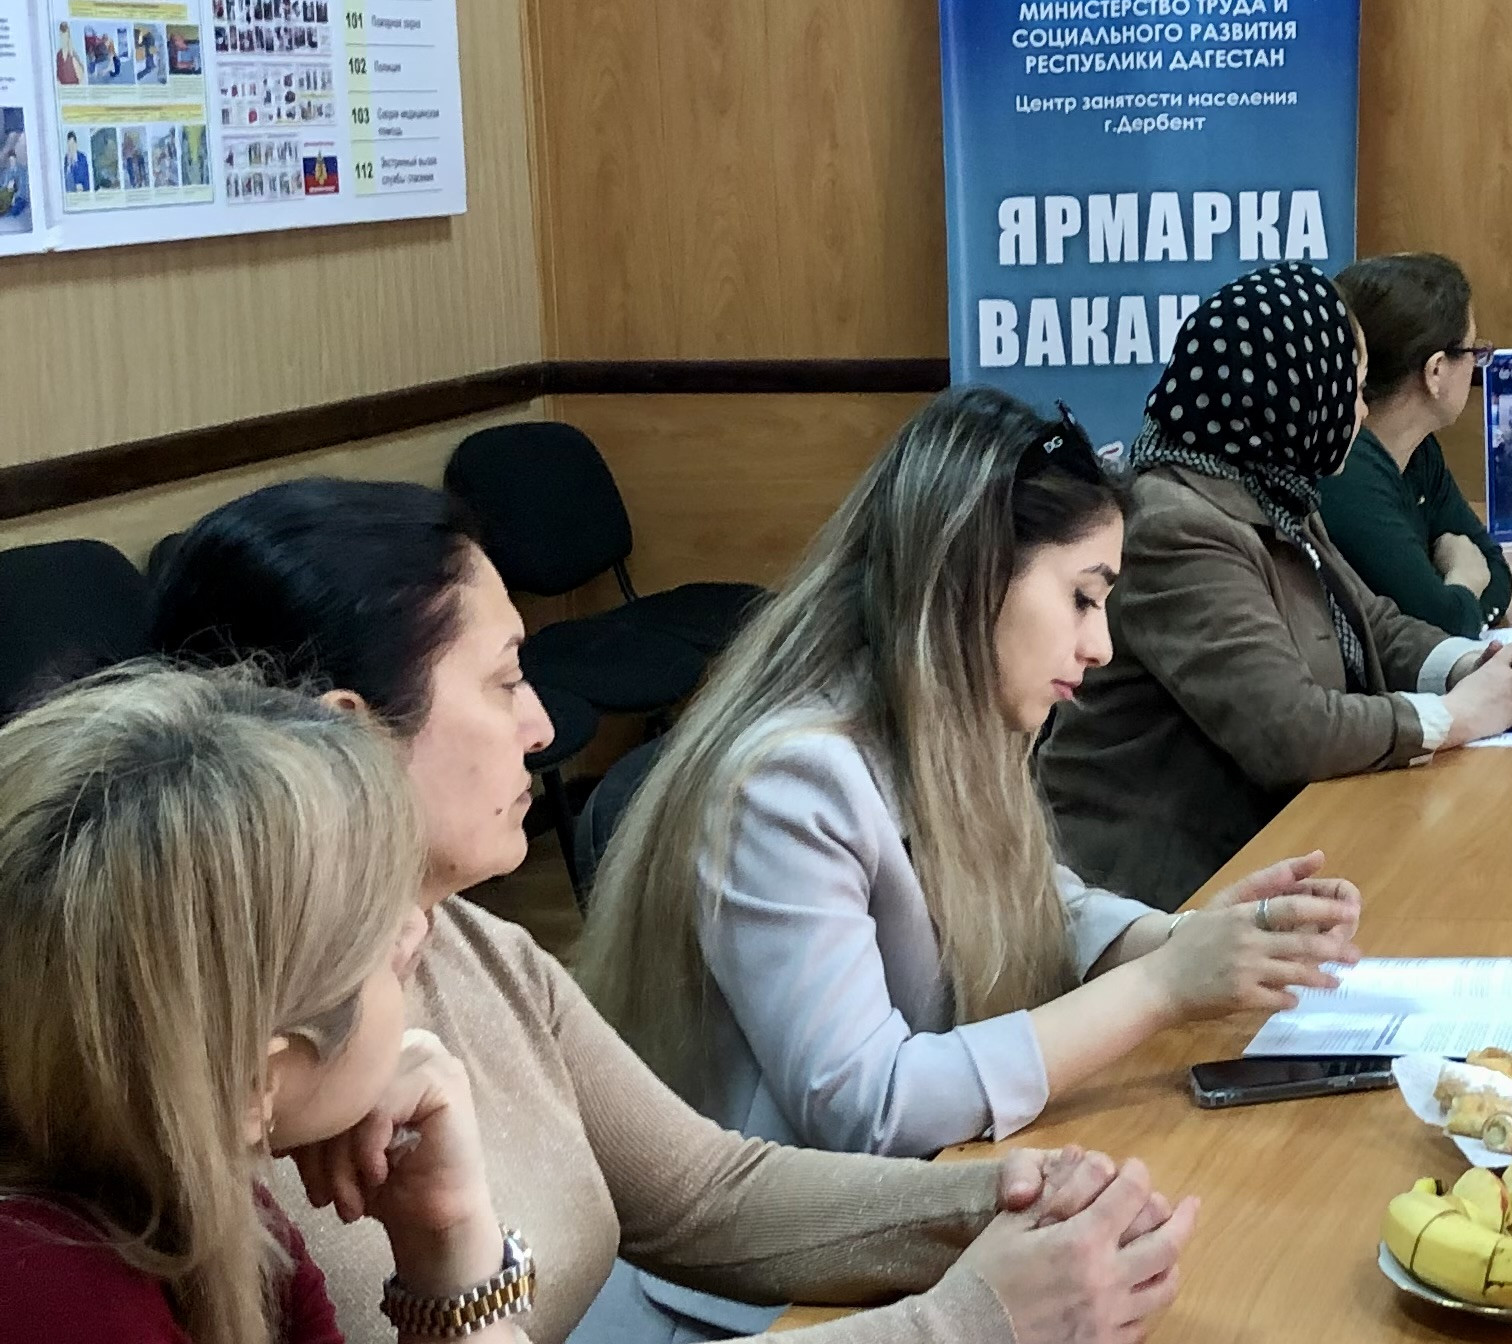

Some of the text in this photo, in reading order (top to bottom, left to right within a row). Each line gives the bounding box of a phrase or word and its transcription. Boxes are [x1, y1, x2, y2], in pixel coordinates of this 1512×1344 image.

[345, 12, 364, 29] 101
[1011, 20, 1297, 49] СОЦИАЛЬНОГО РАЗВИТИЯ
[349, 58, 367, 75] 102
[1025, 47, 1285, 75] РЕСПУБЛИКИ ДАГЕСТАН
[1015, 91, 1298, 114] Центр занятости населения
[352, 107, 371, 125] 103
[1104, 113, 1206, 135] г.Дербент
[355, 161, 374, 180] 112
[997, 189, 1329, 266] ЯРМАРКА
[977, 294, 1201, 367] ВАКАН
